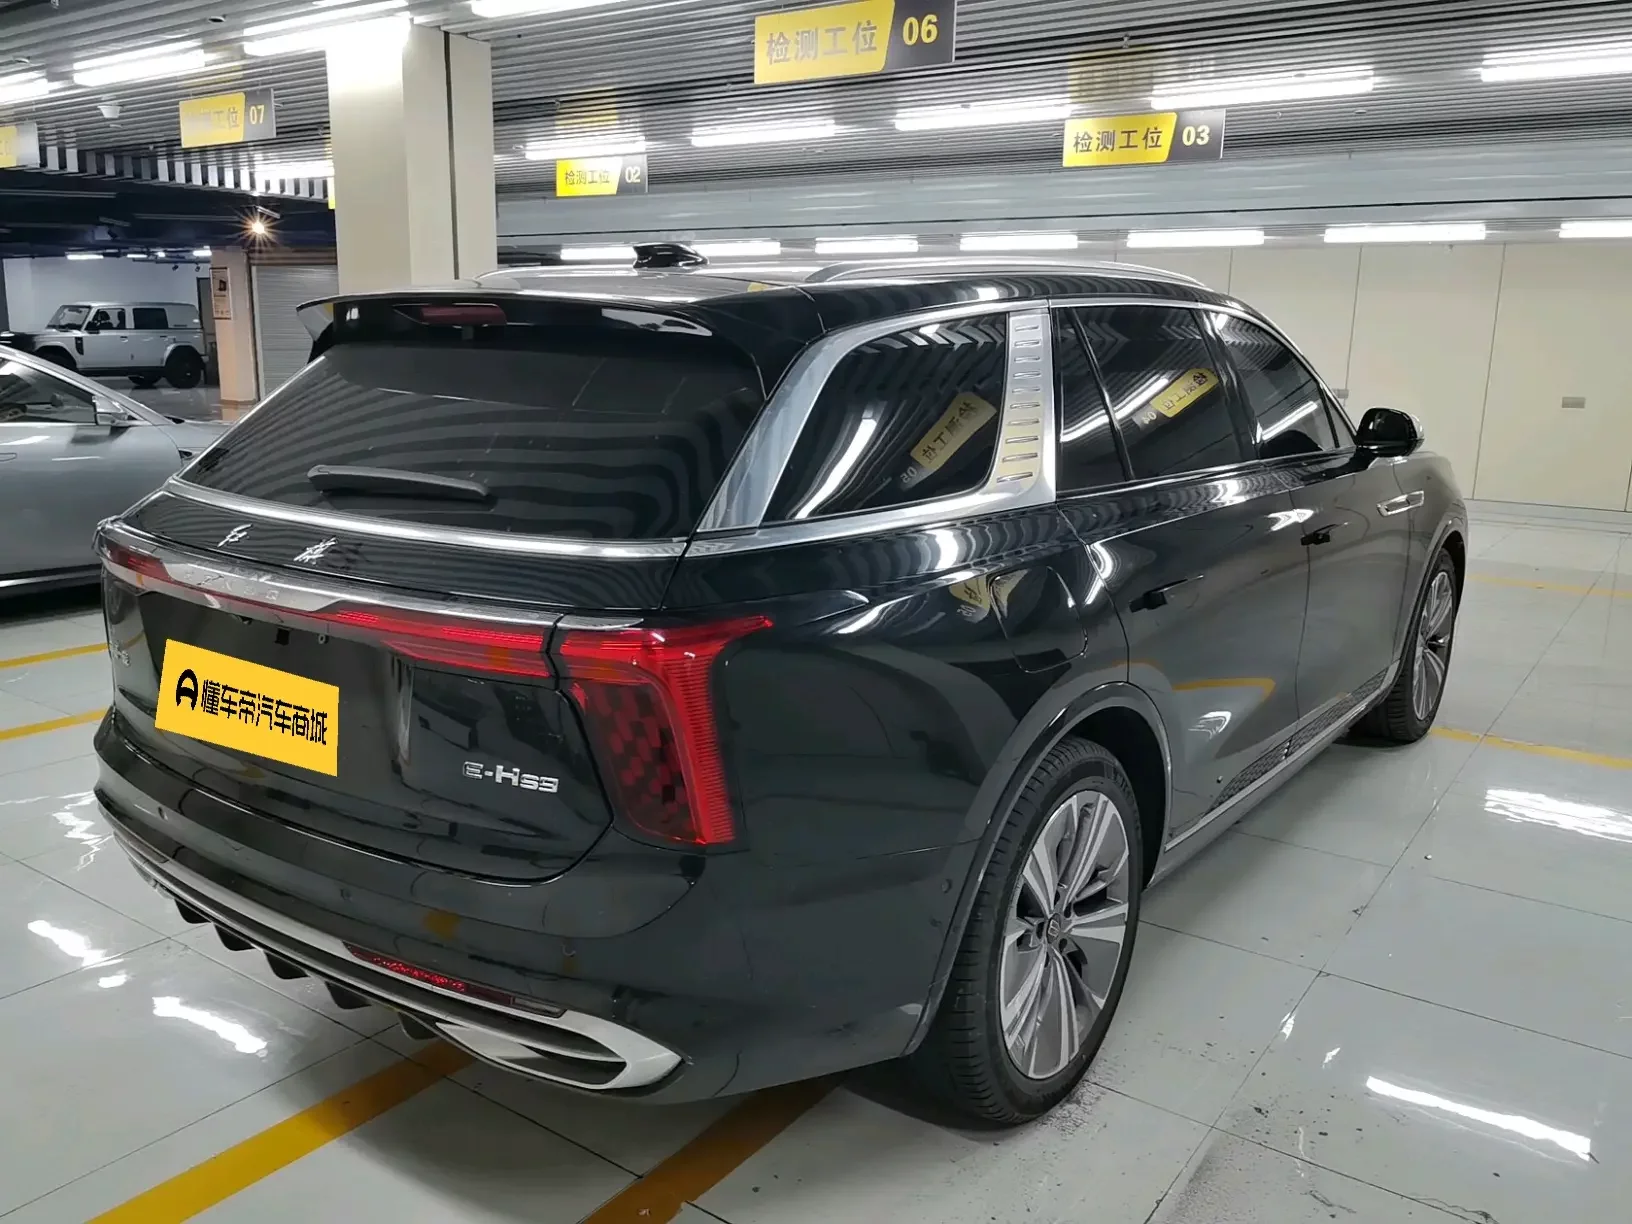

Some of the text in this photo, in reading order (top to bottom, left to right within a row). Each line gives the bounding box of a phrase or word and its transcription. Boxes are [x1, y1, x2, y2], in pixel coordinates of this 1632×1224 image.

[766, 14, 938, 65] 检测工位 06
[249, 104, 265, 125] 07
[1073, 125, 1210, 154] 检测工位 03
[565, 166, 641, 186] 检测工位 02
